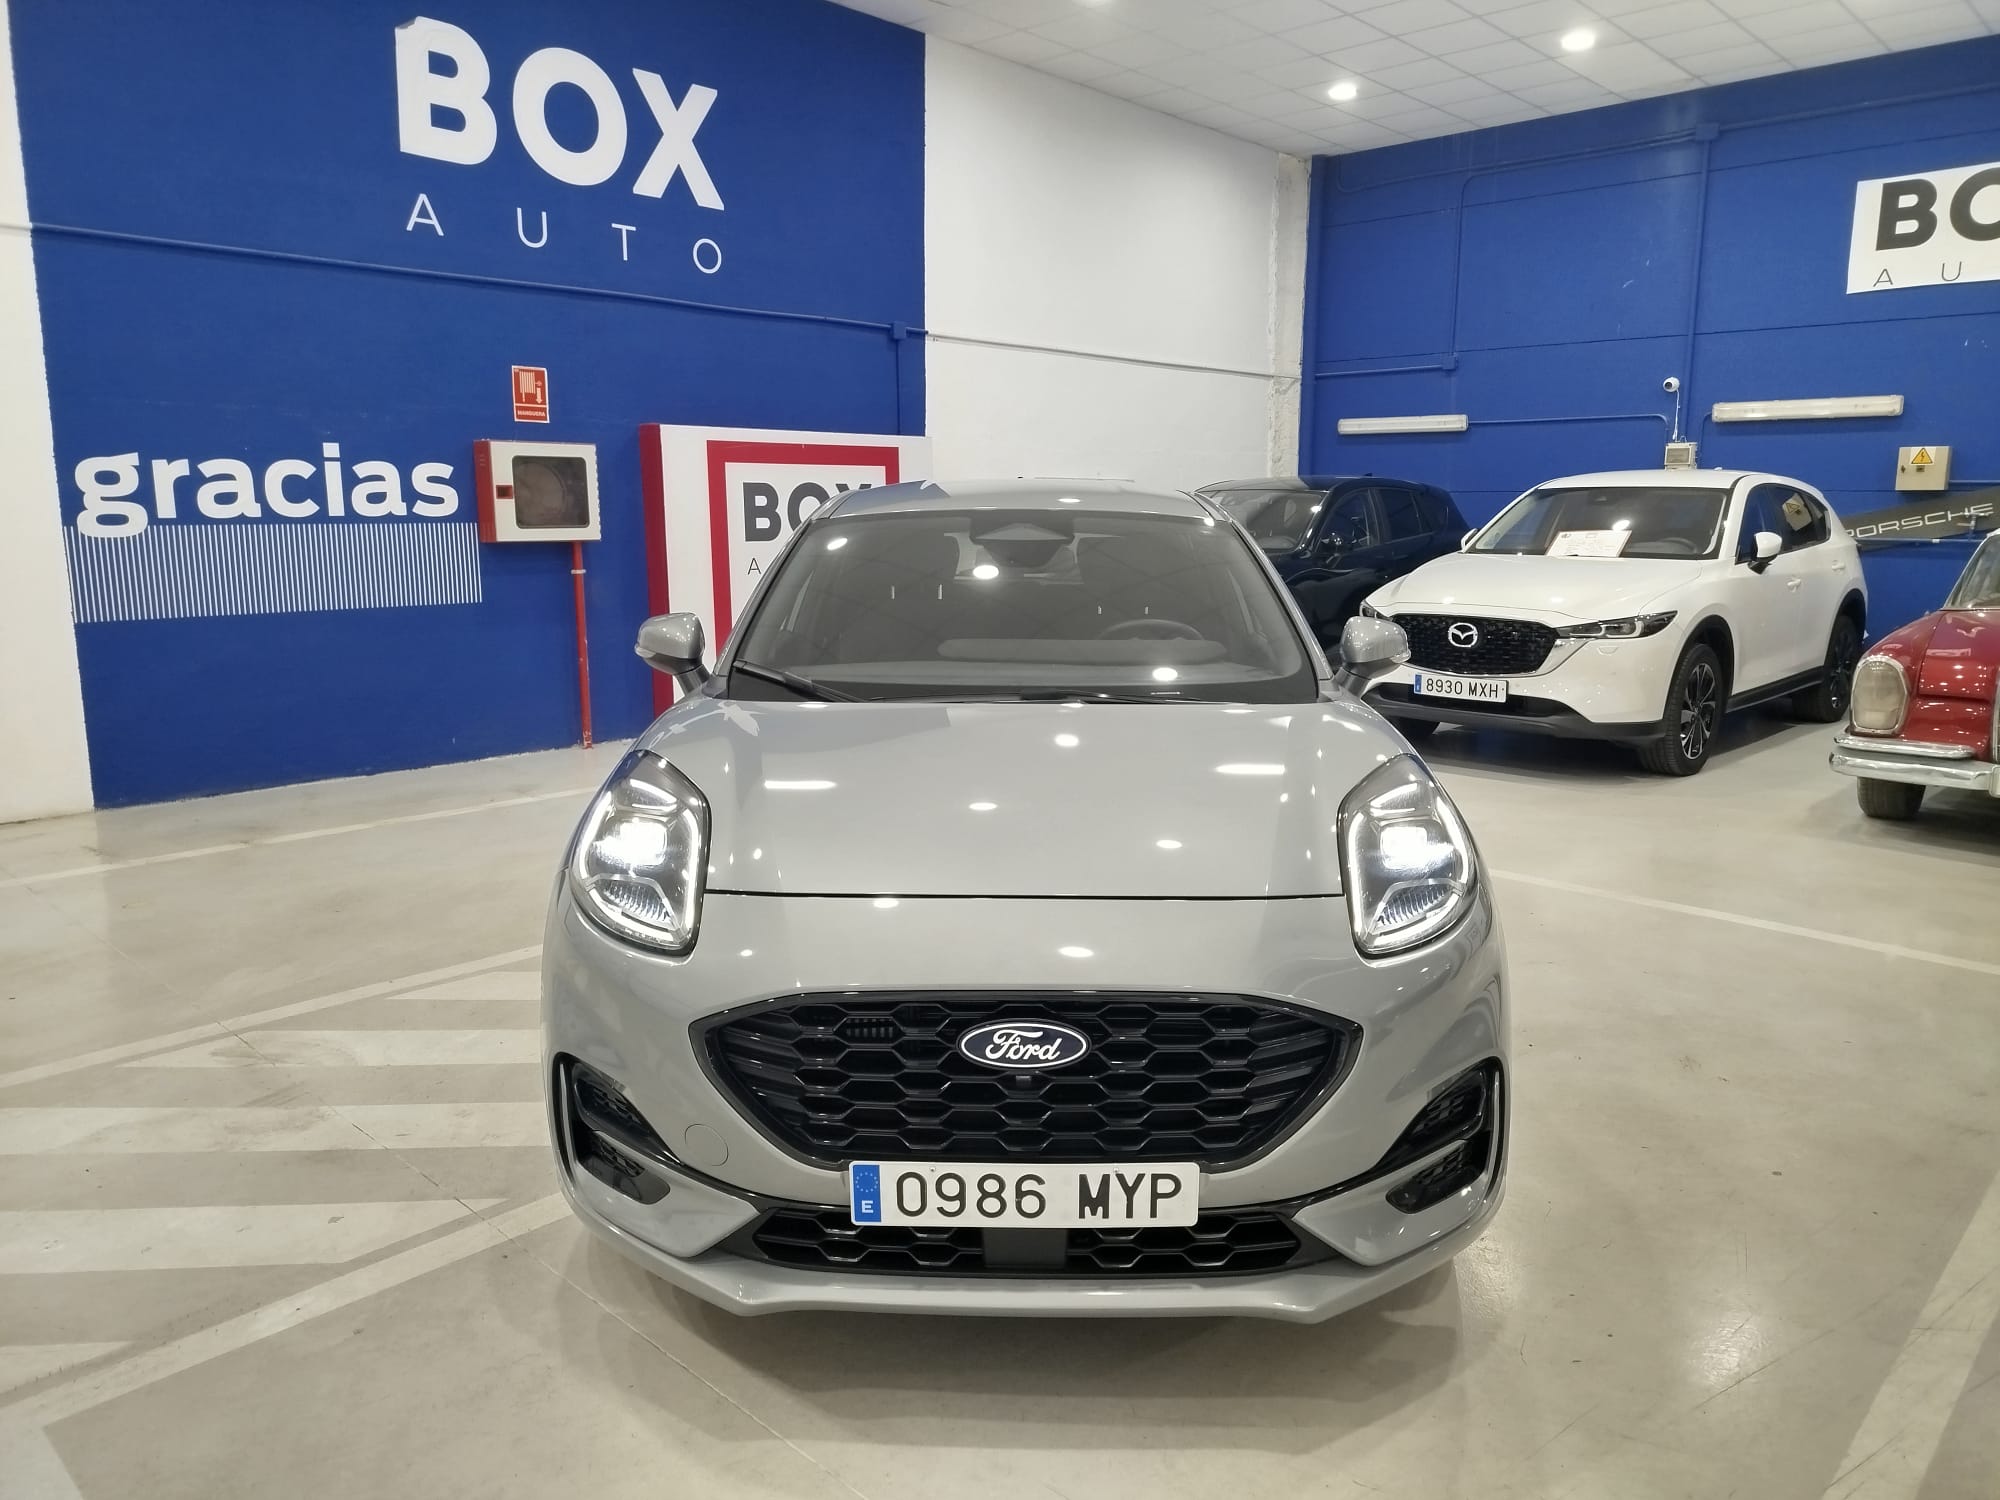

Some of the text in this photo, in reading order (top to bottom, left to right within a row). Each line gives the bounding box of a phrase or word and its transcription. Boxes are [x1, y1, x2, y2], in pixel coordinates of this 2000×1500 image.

[395, 16, 725, 211] BOX
[406, 193, 723, 274] AUTO
[74, 441, 460, 538] gracias
[742, 481, 873, 542] BO
[1426, 678, 1498, 699] 8930 MXH
[985, 1029, 1063, 1060] Ford
[861, 1171, 1183, 1219] E 0986 MYP
